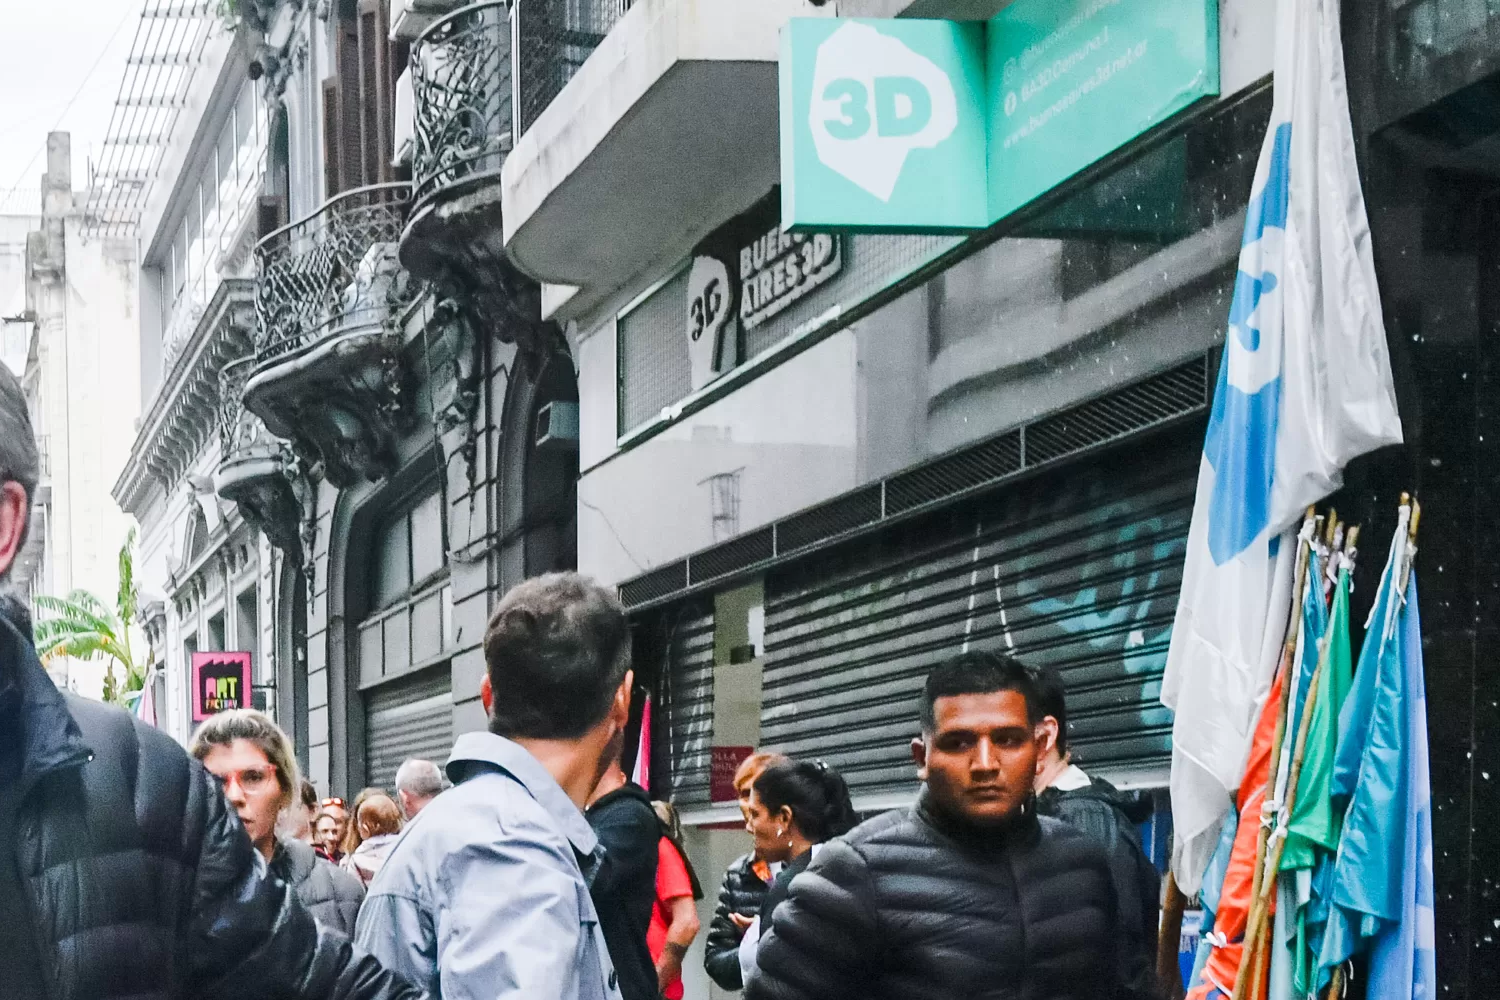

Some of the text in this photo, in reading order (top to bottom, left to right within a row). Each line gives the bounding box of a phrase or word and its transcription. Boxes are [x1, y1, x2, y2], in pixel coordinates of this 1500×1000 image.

[822, 76, 932, 141] 3D
[740, 225, 803, 279] BUEN
[740, 232, 833, 318] AIRES 3D
[691, 278, 721, 342] 3D
[205, 676, 238, 699] ART
